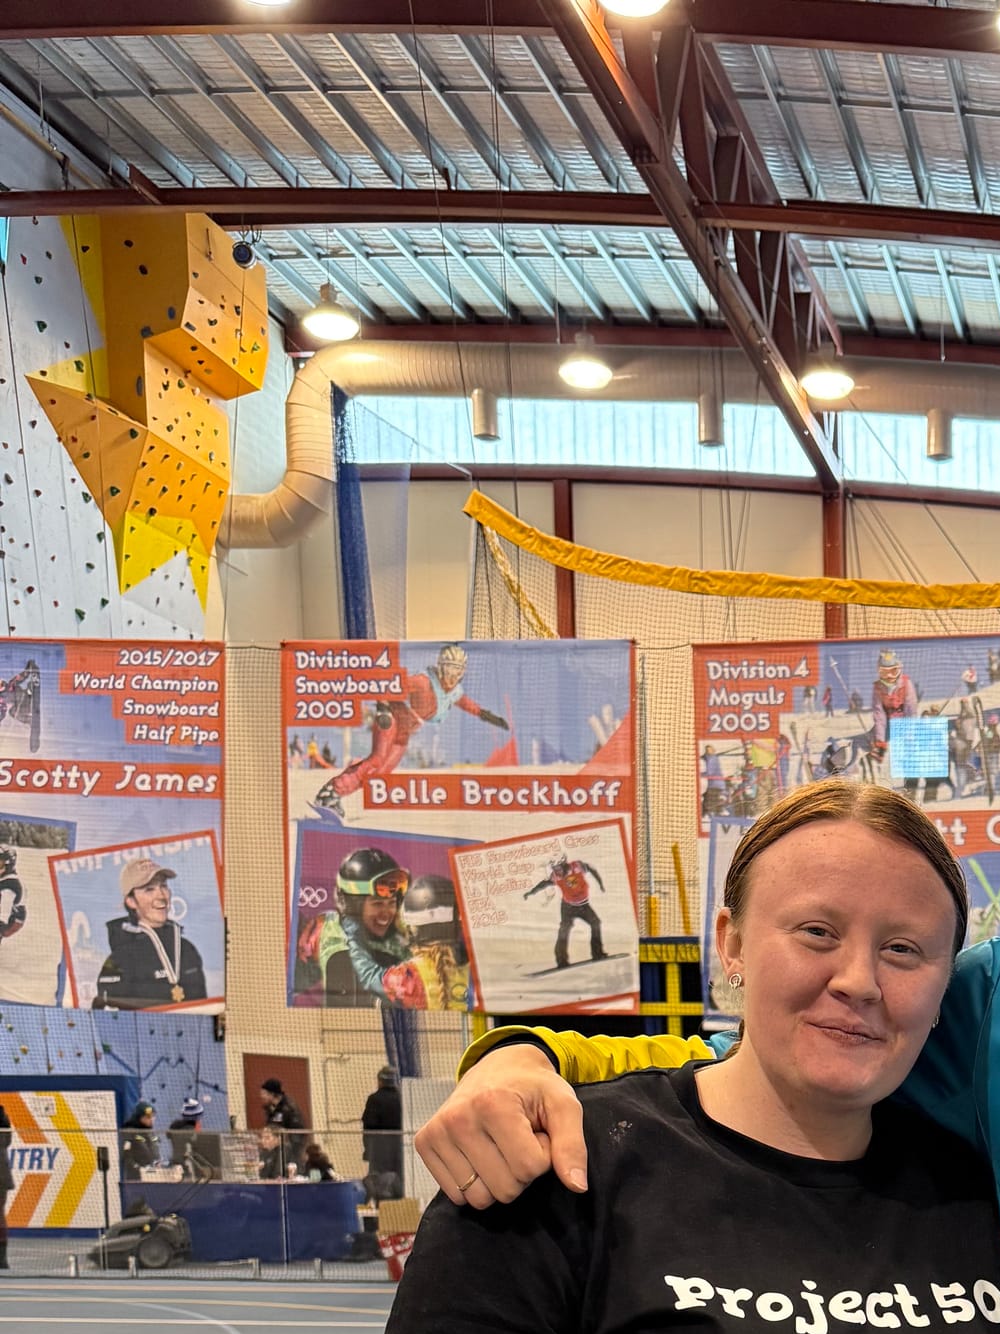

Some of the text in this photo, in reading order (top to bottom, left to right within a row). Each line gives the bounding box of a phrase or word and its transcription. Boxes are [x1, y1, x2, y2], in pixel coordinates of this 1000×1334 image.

[118, 648, 220, 668] 2015/2017
[295, 649, 390, 670] Division 4
[707, 657, 810, 681] Division 4
[73, 673, 220, 694] World Champion
[294, 675, 403, 696] Snowboard
[707, 686, 786, 708] Moguls
[123, 699, 220, 718] Snowboard
[294, 700, 355, 721] 2005
[708, 712, 771, 733] 2005
[133, 723, 220, 744] Half Pipe
[0, 761, 219, 797] Scotty James
[368, 778, 623, 808] Belle Brockhoff
[486, 838, 562, 864] Snowboard
[564, 834, 600, 849] Cross
[462, 863, 504, 882] World
